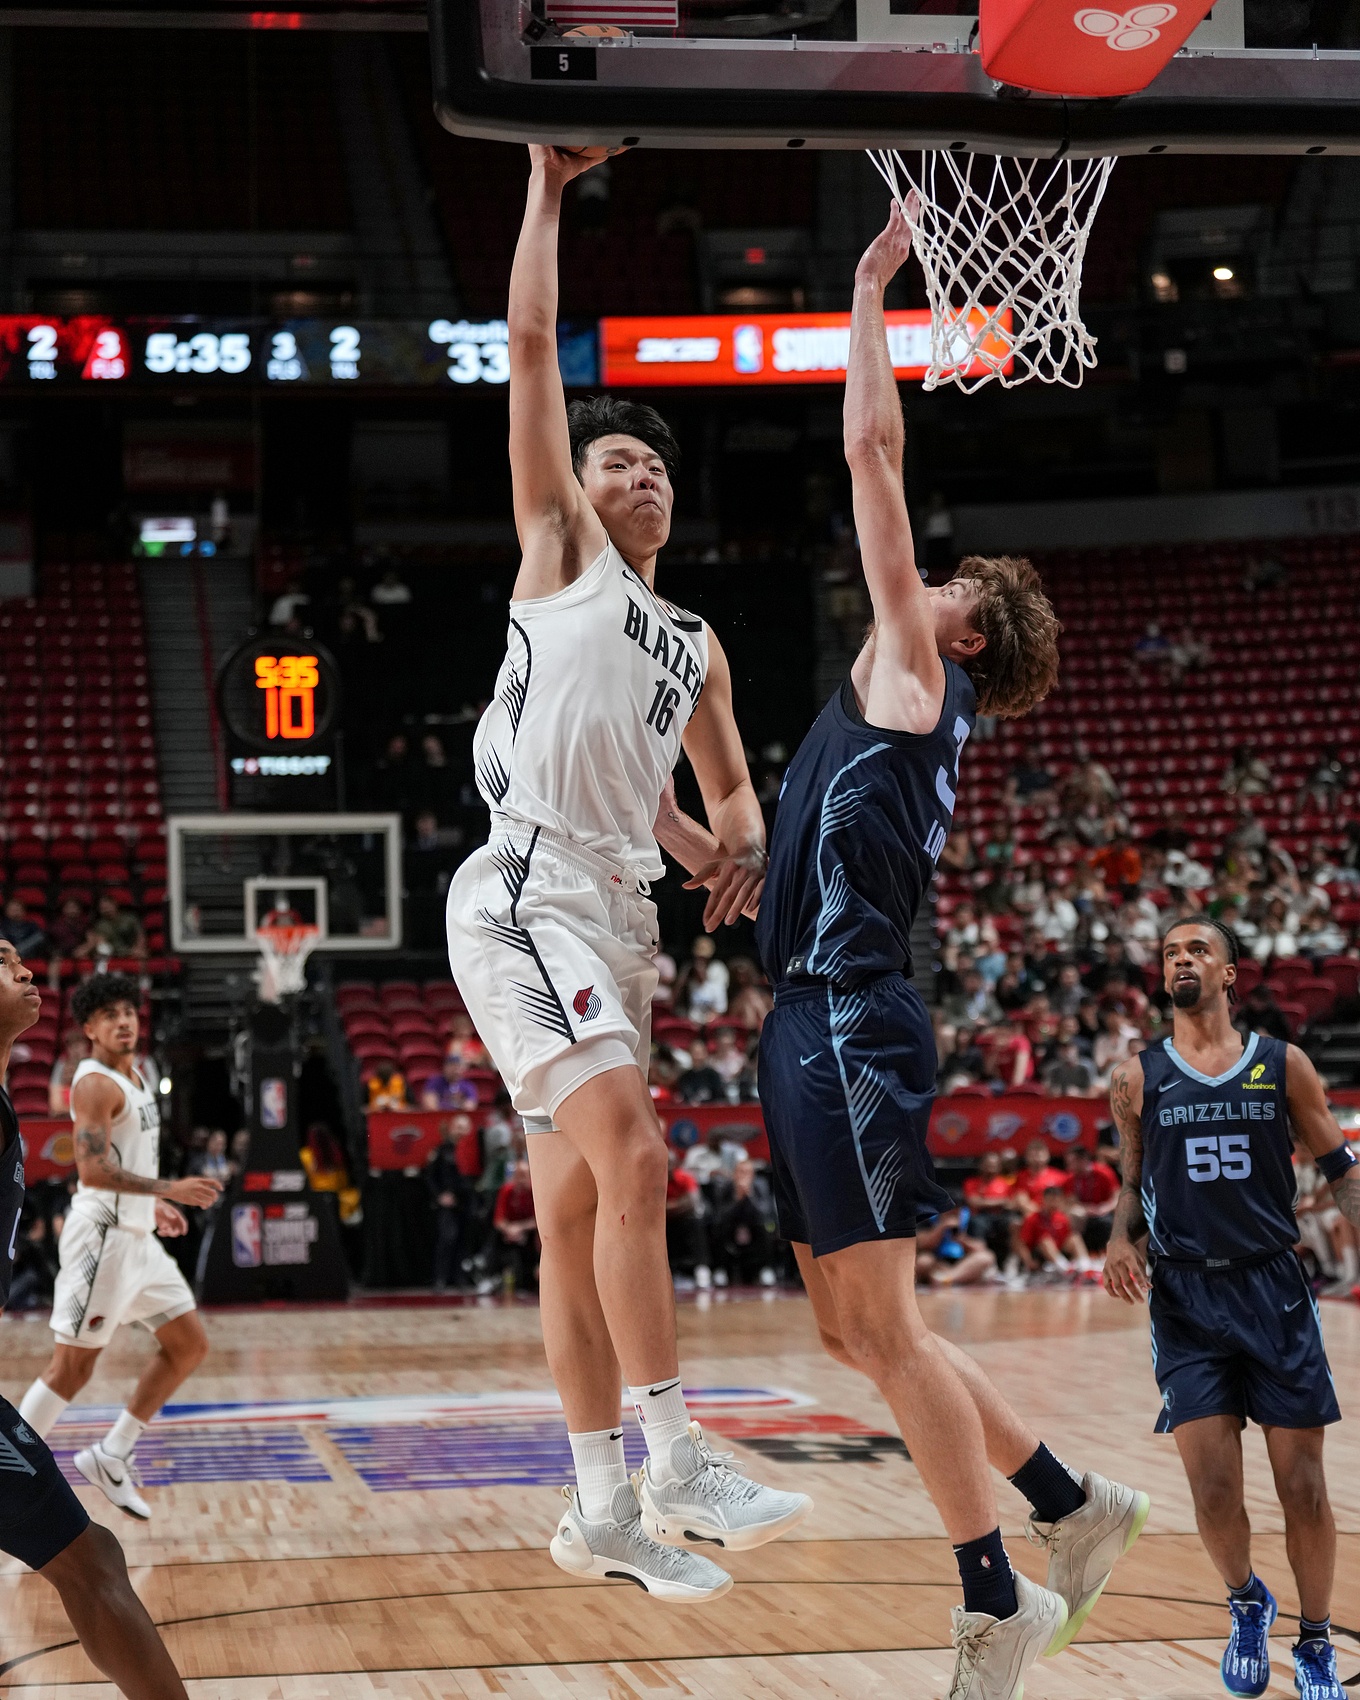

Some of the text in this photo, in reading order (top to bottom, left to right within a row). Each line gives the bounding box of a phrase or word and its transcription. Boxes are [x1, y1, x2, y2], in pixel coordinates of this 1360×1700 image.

[559, 53, 569, 72] 5
[27, 325, 58, 361] 2
[96, 330, 121, 360] 3
[145, 332, 251, 374] 5:35
[271, 331, 297, 360] 3
[330, 326, 361, 362] 2
[447, 343, 510, 384] 33
[265, 686, 315, 740] 10
[646, 678, 681, 737] 16
[1159, 1102, 1276, 1127] GRIZZLIES
[1185, 1134, 1252, 1183] 55
